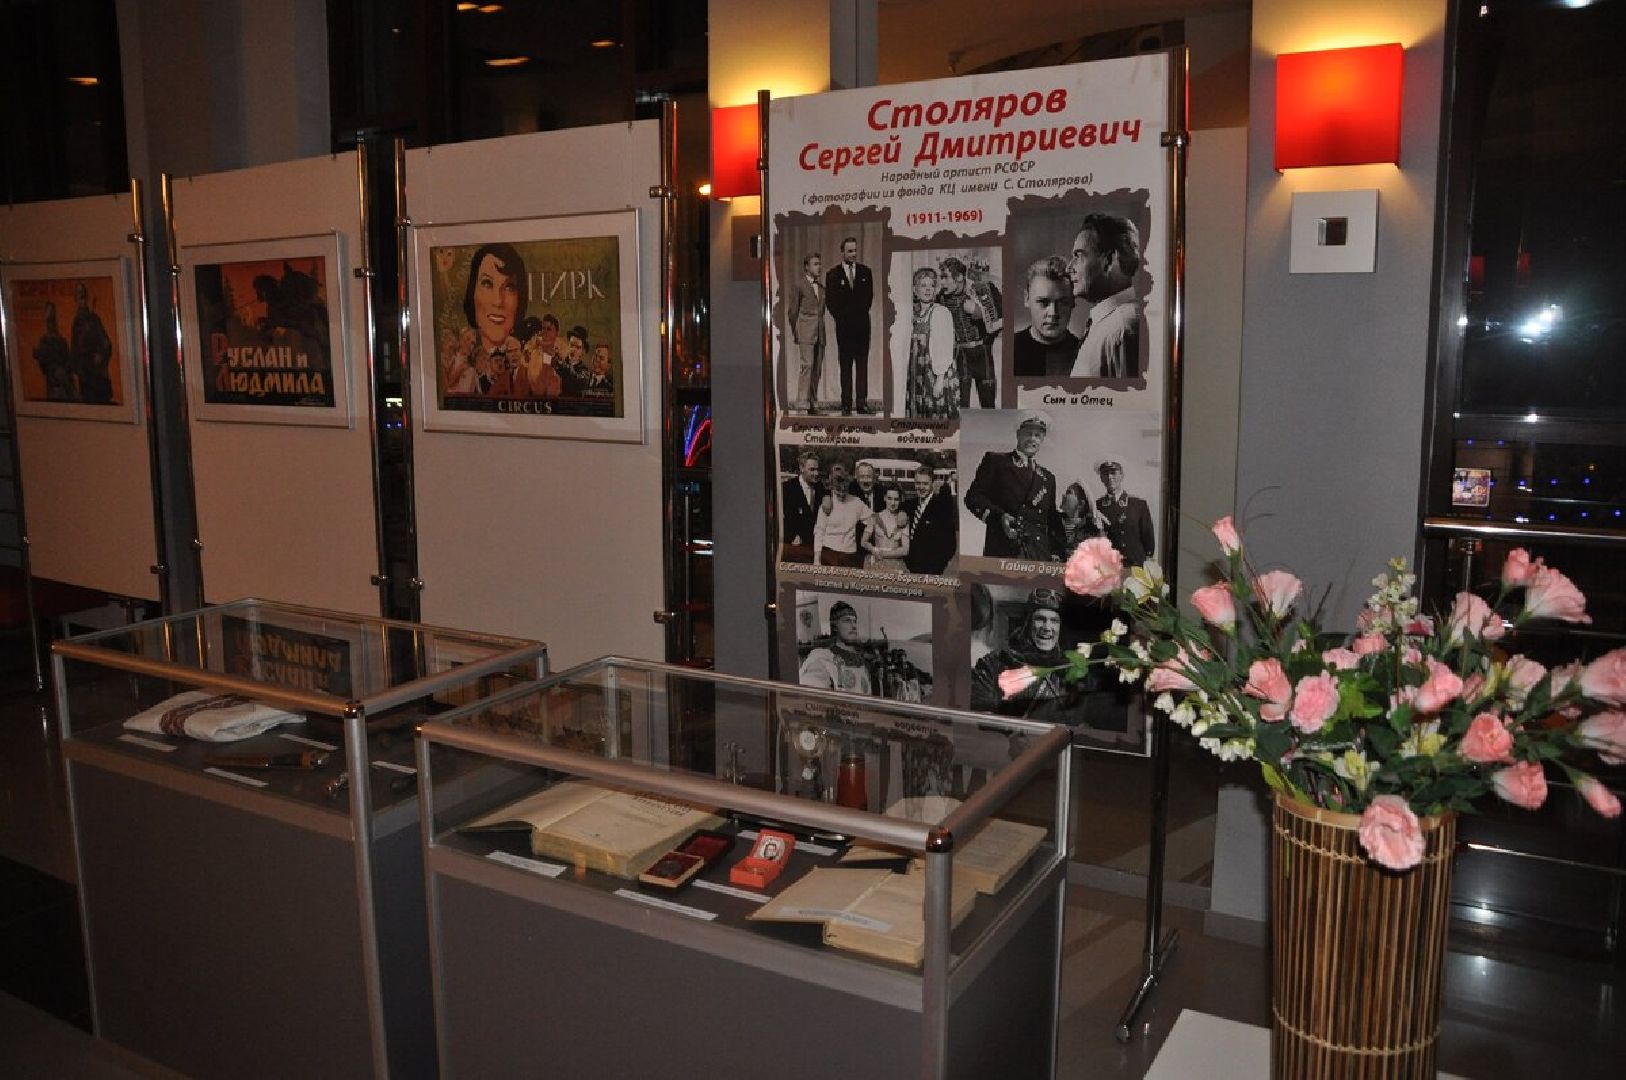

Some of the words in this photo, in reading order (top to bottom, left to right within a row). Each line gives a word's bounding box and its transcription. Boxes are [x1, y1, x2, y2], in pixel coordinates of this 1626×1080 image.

[867, 88, 1067, 131] Столяров
[799, 136, 901, 176] Сергей
[913, 119, 1142, 167] Дмитриевич
[880, 167, 941, 185] Народный
[943, 164, 992, 181] артист
[994, 160, 1036, 176] РСФСР
[883, 189, 895, 199] из
[897, 185, 934, 200] фонда
[939, 182, 956, 196] КЦ
[960, 181, 998, 194] имени
[1003, 178, 1014, 190] С.
[1017, 173, 1094, 191] Столярова)
[906, 209, 984, 227] (1911-1969)
[528, 269, 606, 303] ЦИРК
[215, 363, 326, 397] ЛЮДМИЛА
[498, 400, 553, 414] CIRCUS
[1042, 393, 1066, 407] Сын
[1070, 396, 1078, 406] и
[1080, 394, 1113, 408] Отец
[803, 433, 861, 446] Столяровы
[1000, 560, 1036, 573] Тайна
